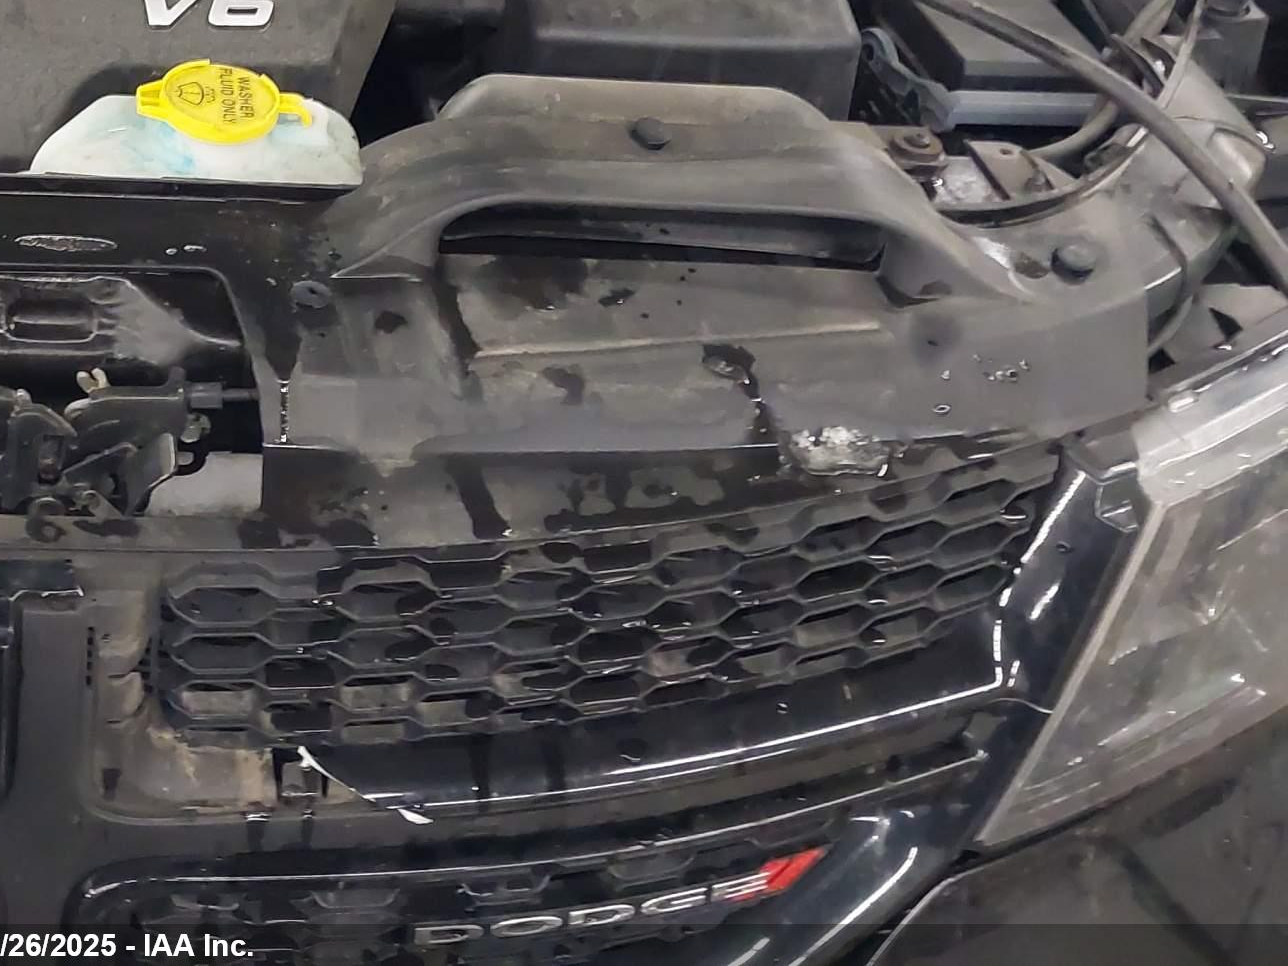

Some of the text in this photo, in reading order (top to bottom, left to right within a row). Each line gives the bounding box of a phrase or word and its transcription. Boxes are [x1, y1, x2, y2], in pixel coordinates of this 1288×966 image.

[219, 68, 238, 125] FLUID ONLY
[236, 76, 255, 119] WASHER
[414, 872, 774, 944] DODGE
